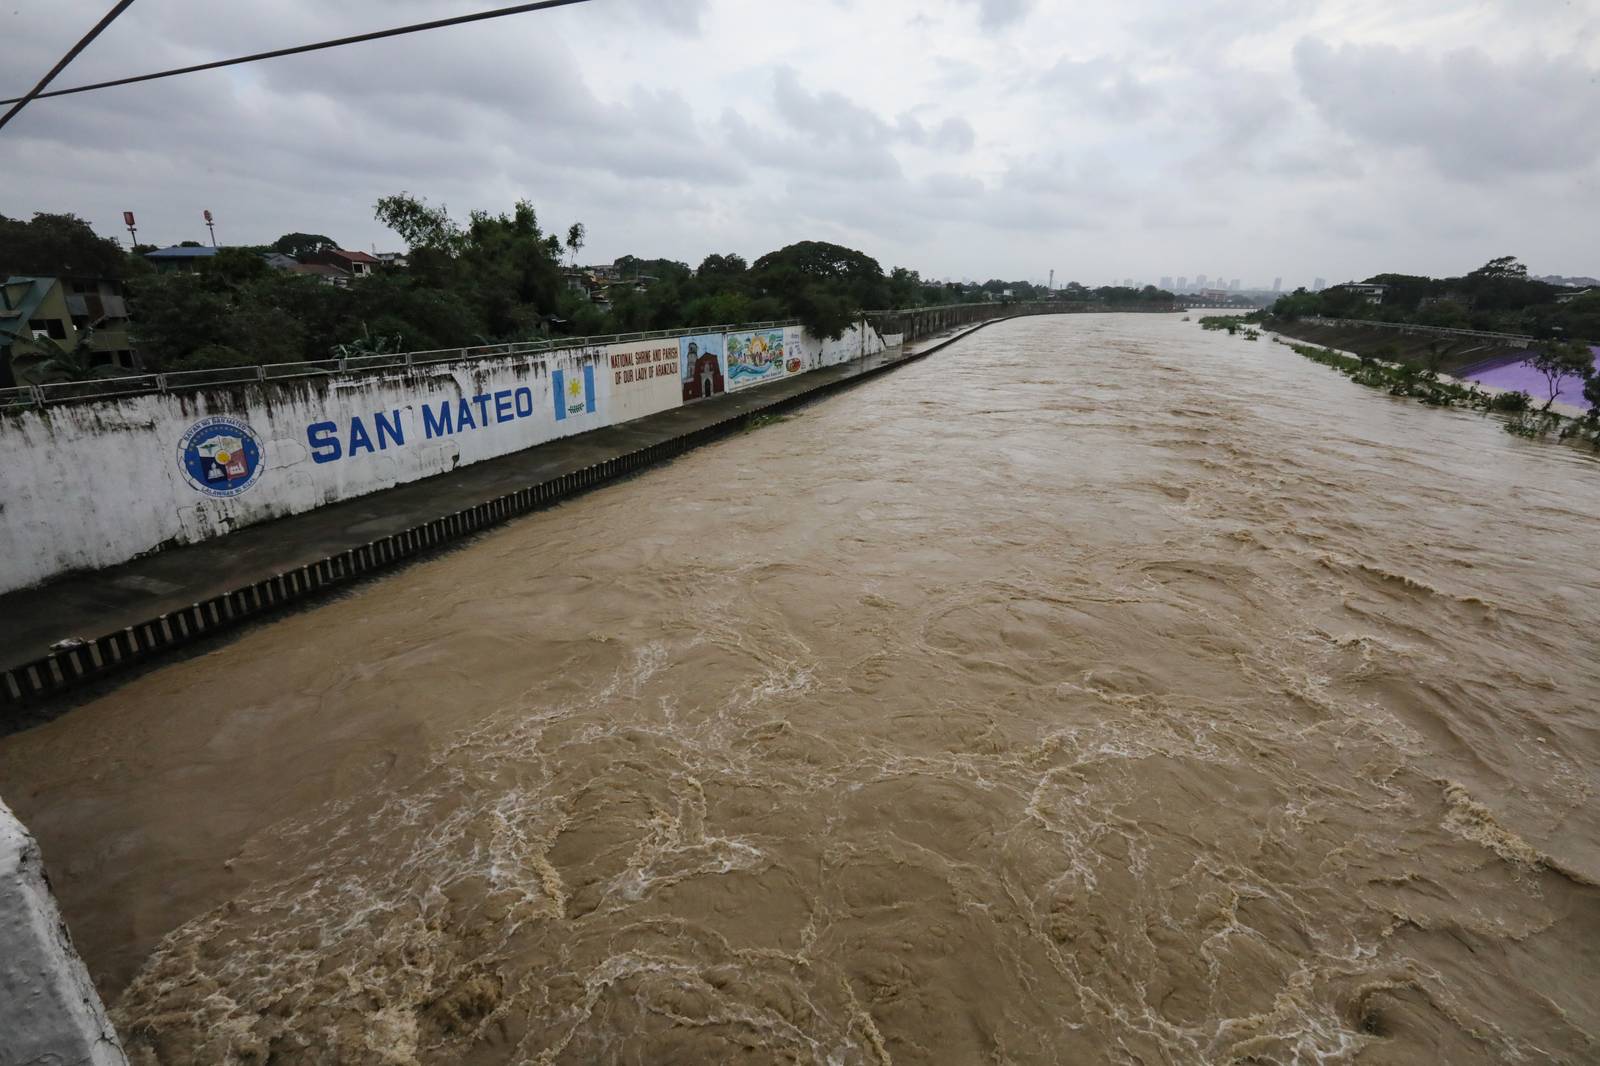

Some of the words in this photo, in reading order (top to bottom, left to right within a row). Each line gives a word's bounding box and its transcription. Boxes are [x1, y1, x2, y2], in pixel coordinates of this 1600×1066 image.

[611, 352, 634, 369] NATIONAL
[635, 350, 651, 365] SHRINE
[652, 348, 662, 362] AND
[662, 347, 678, 360] PARISH
[615, 371, 621, 385] OF
[623, 369, 634, 383] OUR
[635, 367, 647, 381] LADY
[648, 365, 654, 378] OF
[183, 423, 201, 441] BAYAN
[225, 417, 247, 431] MATEO
[306, 409, 405, 465] SAN
[421, 386, 533, 440] MATEO
